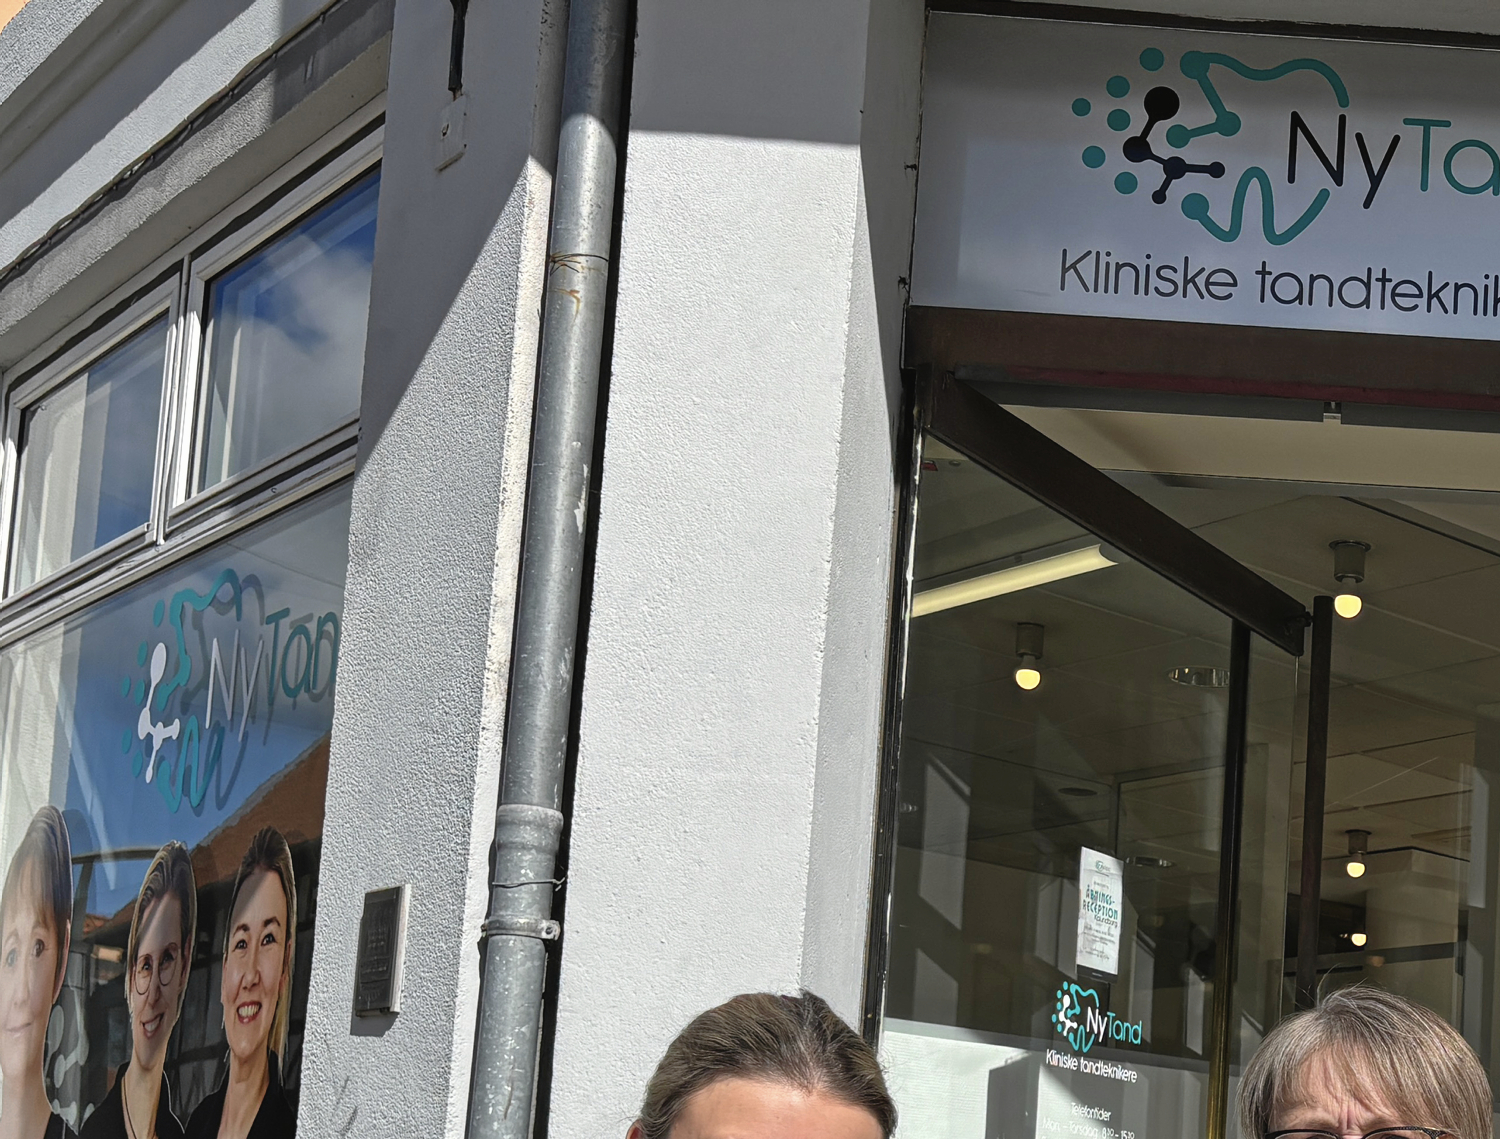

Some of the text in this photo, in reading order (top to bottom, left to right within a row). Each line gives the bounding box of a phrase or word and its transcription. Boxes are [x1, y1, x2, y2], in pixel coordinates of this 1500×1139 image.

[1060, 246, 1236, 303] Kliniske
[205, 607, 339, 742] NyTan
[1086, 1006, 1143, 1045] NyTand
[1046, 1048, 1138, 1083] Kliniske tandteknikere
